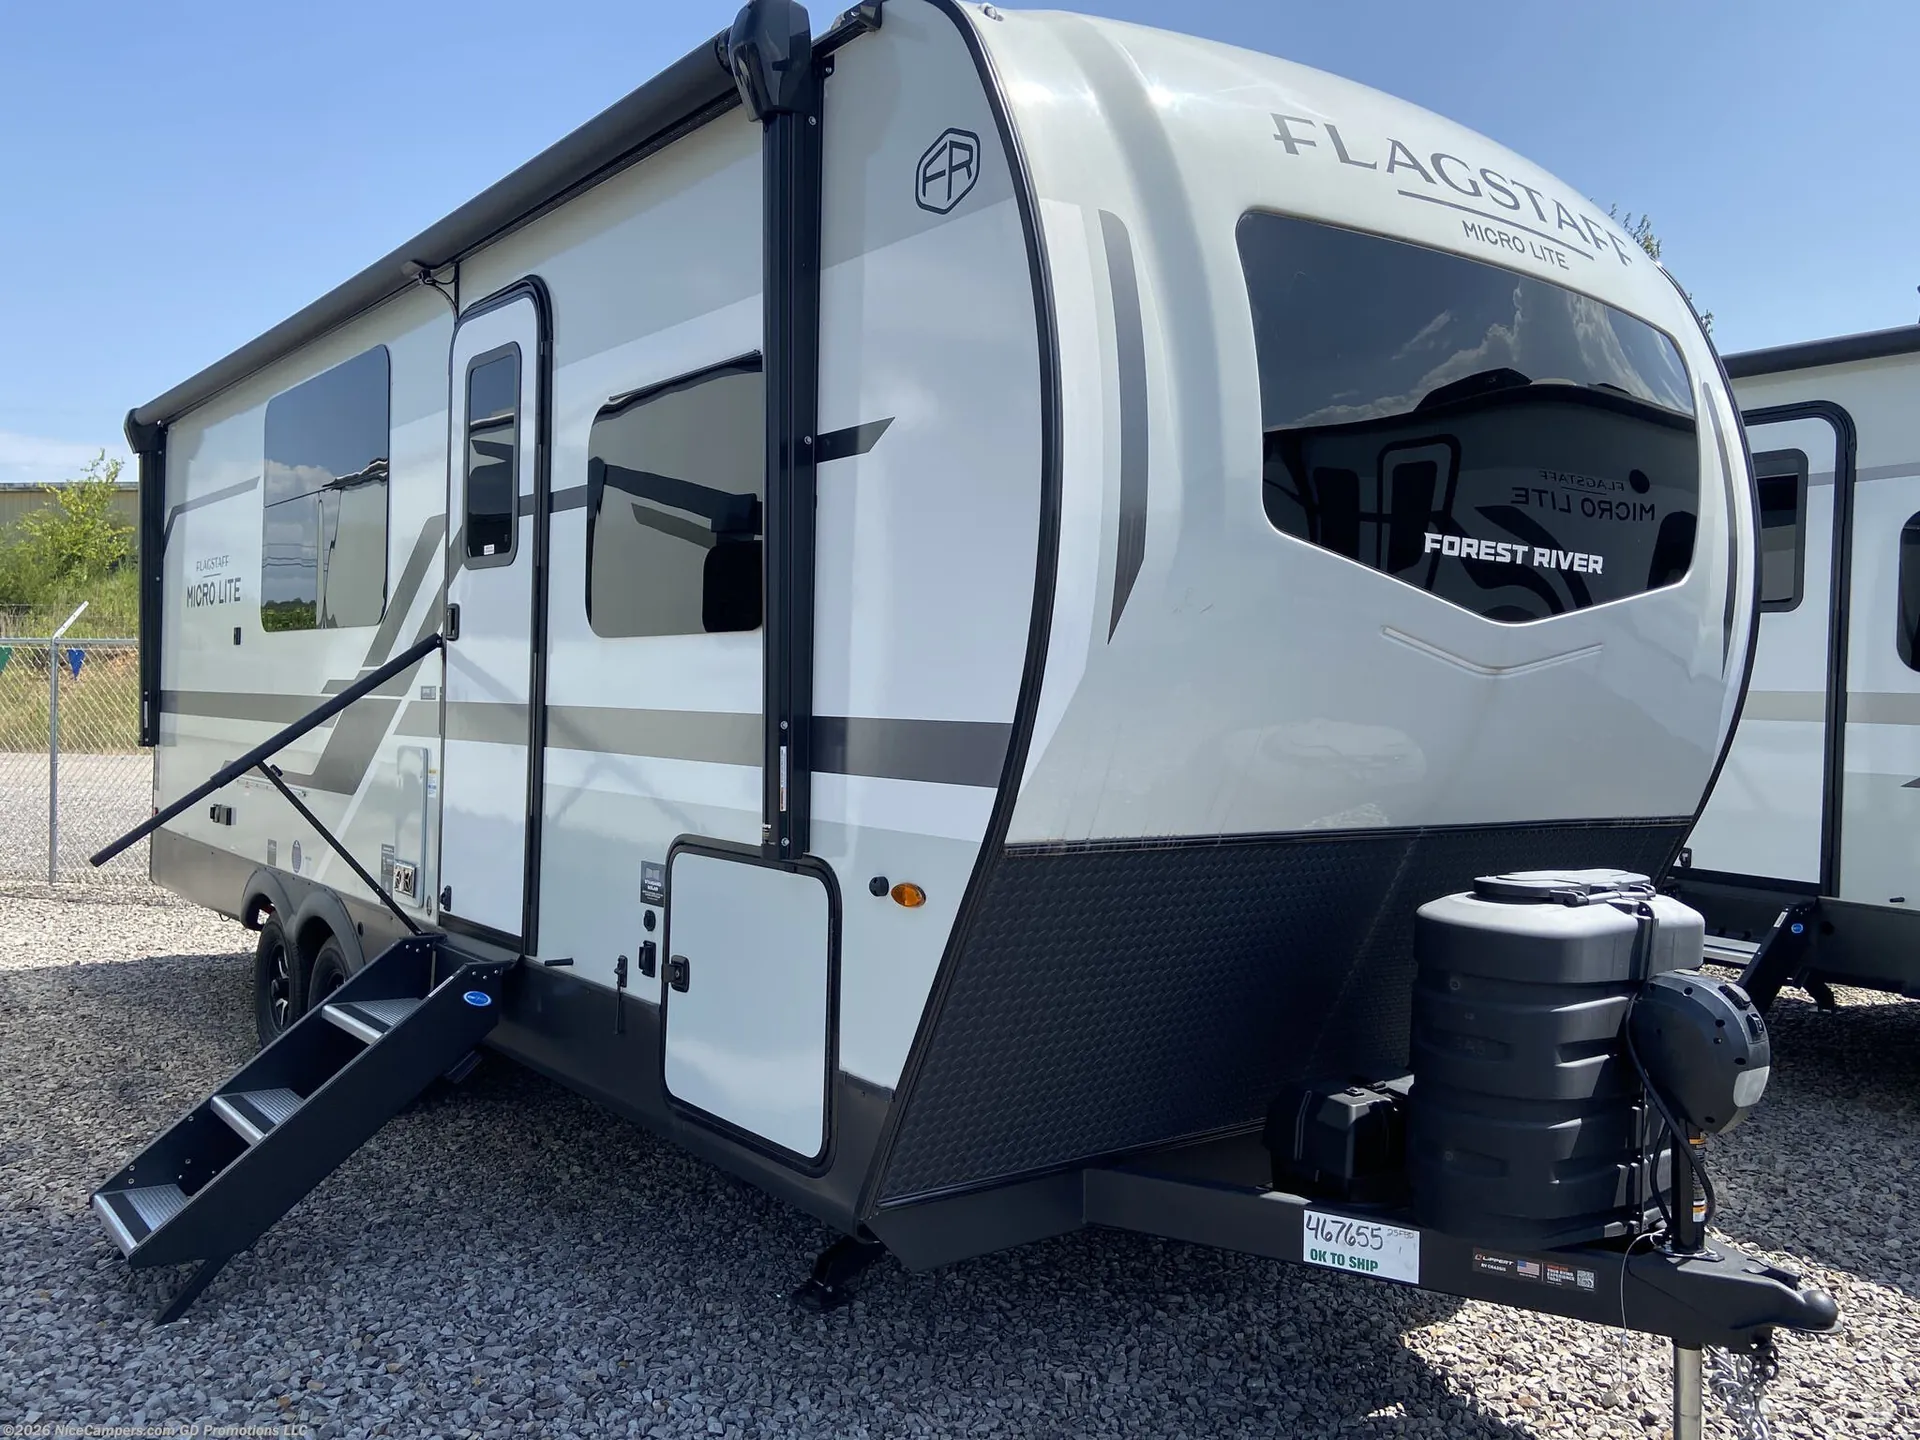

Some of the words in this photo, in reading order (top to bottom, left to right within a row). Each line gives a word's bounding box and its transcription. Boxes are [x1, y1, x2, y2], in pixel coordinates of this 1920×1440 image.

[1270, 113, 1632, 267] FLAGSTAFF
[1462, 220, 1525, 254] MICRO
[1532, 245, 1570, 270] LITE
[196, 555, 229, 572] FLAGSTAFF
[1424, 532, 1528, 565] FOREST
[1533, 547, 1604, 574] RIVER
[186, 582, 216, 608] MICRO
[219, 577, 241, 604] LITE
[1306, 1214, 1383, 1250] 467655
[1310, 1249, 1327, 1262] OK
[1330, 1252, 1345, 1266] TO
[1349, 1256, 1378, 1272] SHIP
